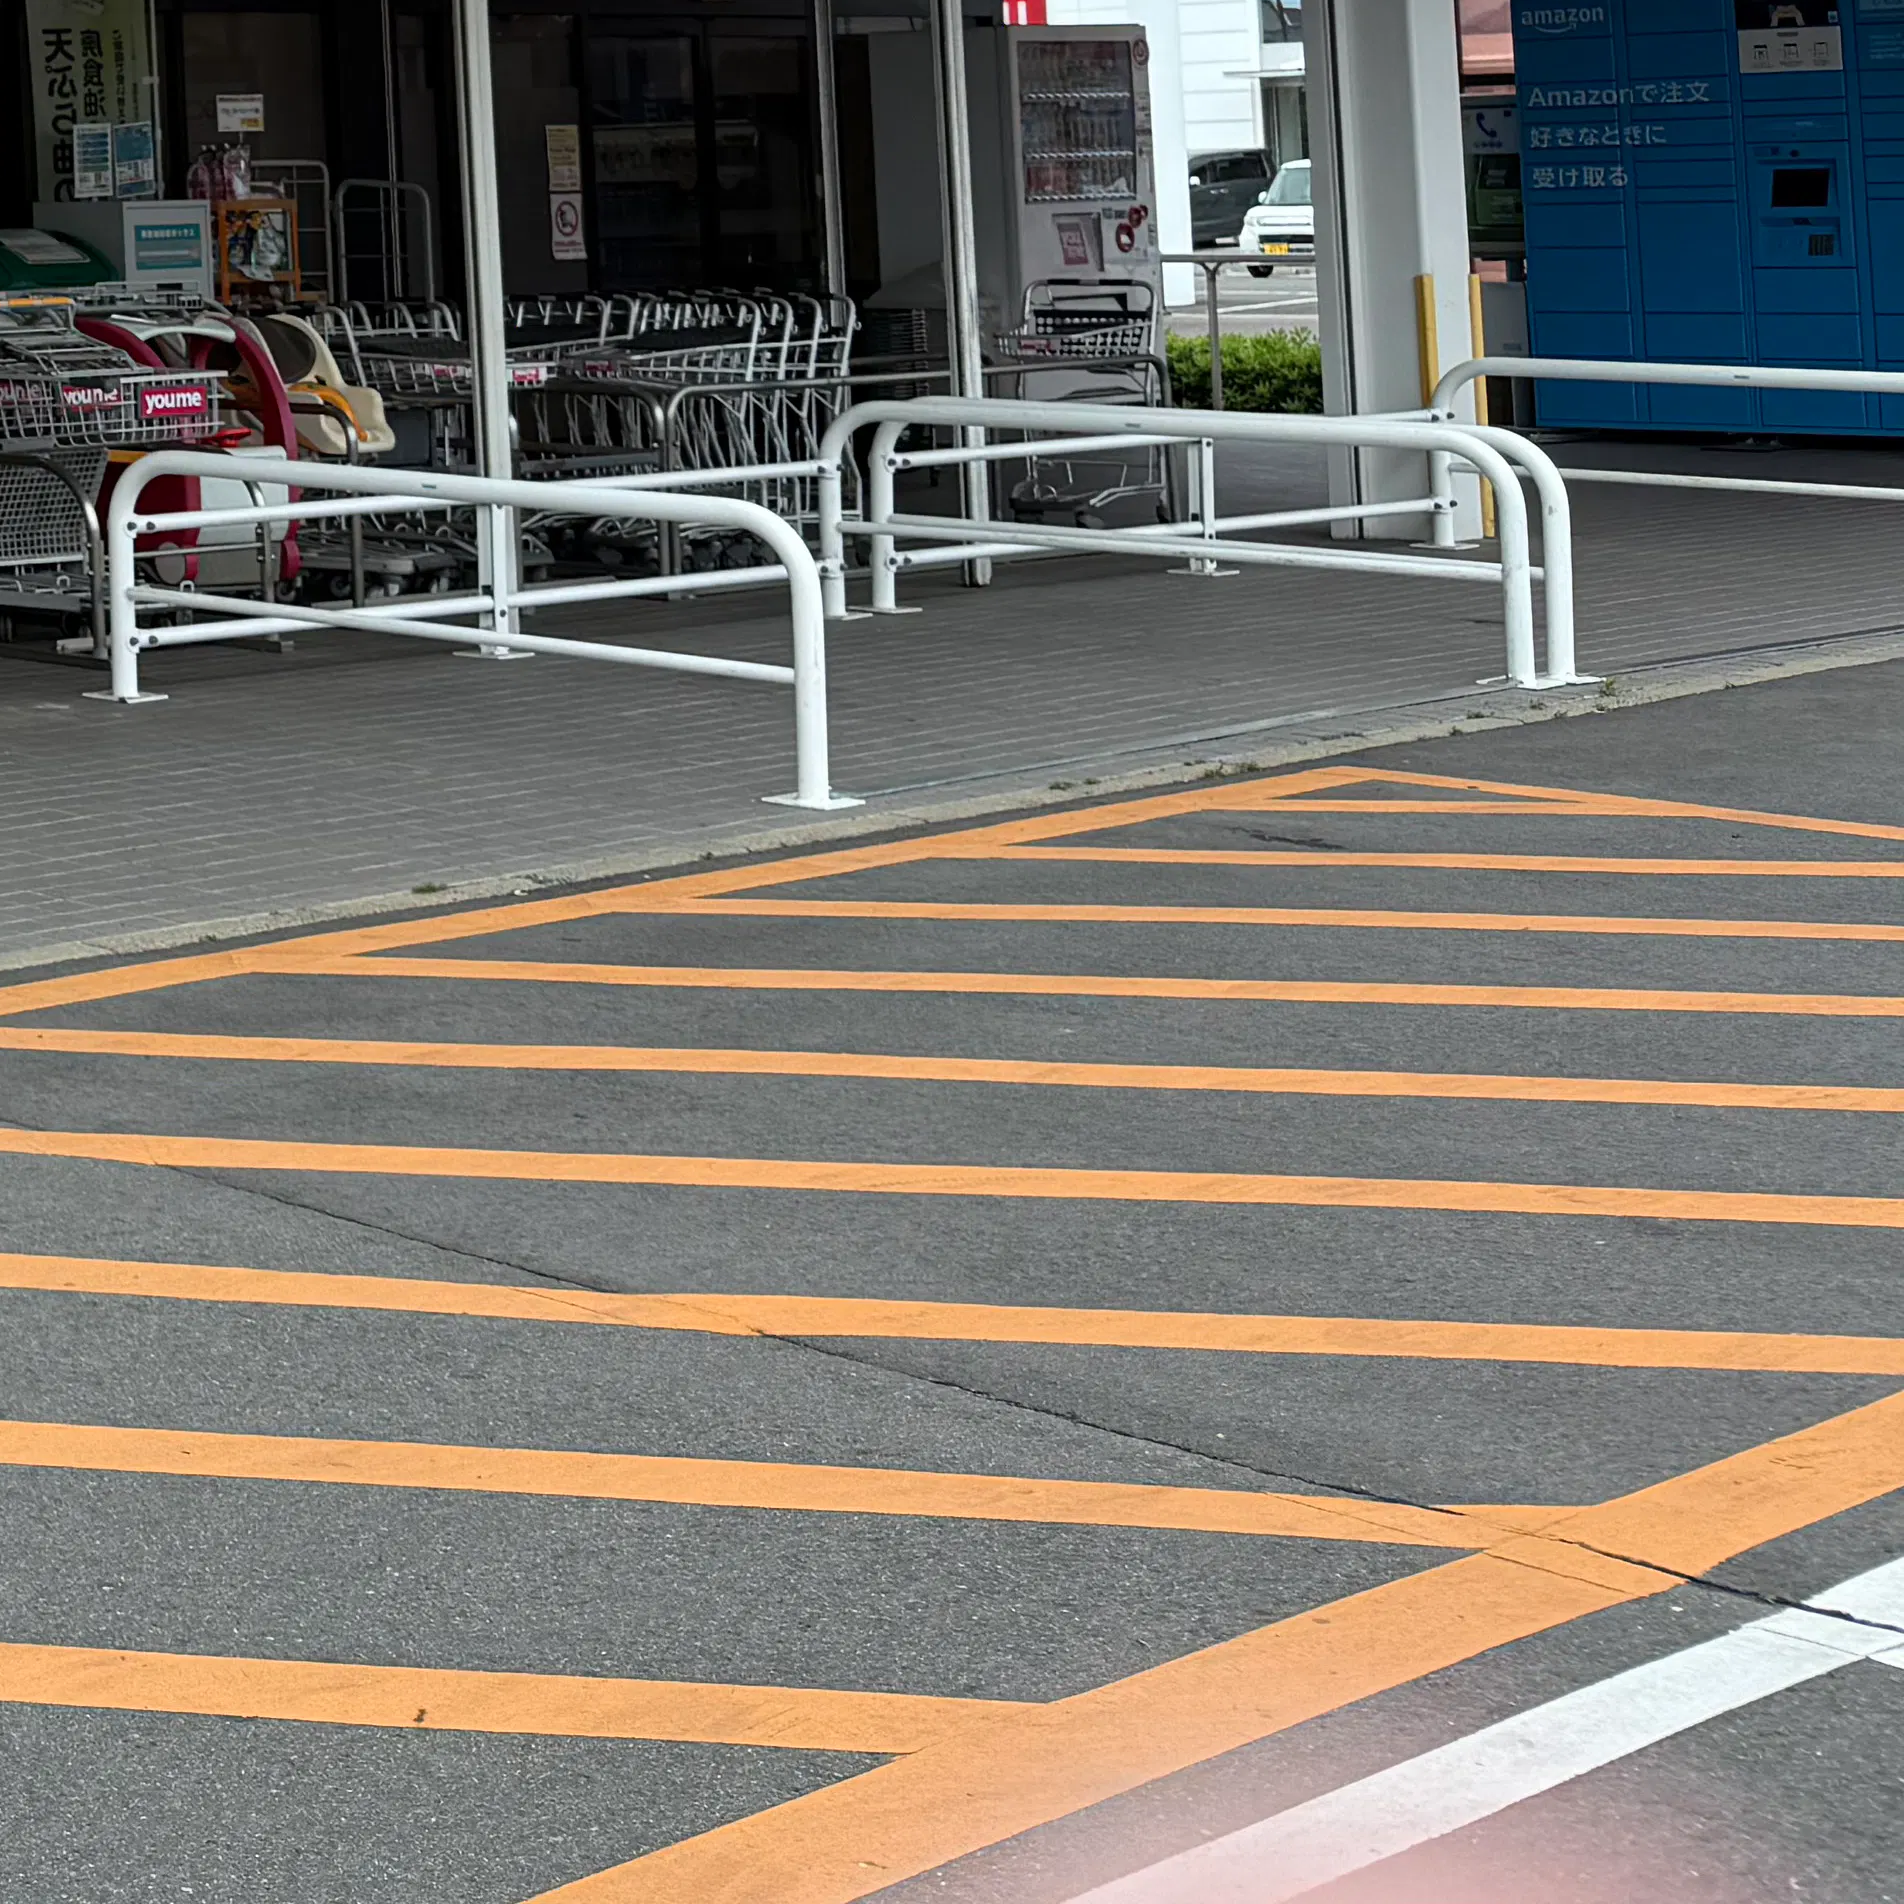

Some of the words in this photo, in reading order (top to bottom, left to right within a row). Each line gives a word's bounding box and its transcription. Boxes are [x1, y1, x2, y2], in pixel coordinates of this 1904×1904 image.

[1521, 7, 1604, 26] amazon
[1527, 81, 1711, 107] Amazonで注文
[1530, 125, 1667, 148] 好きなときに
[1532, 166, 1629, 188] 受け取る
[144, 390, 202, 414] youme
